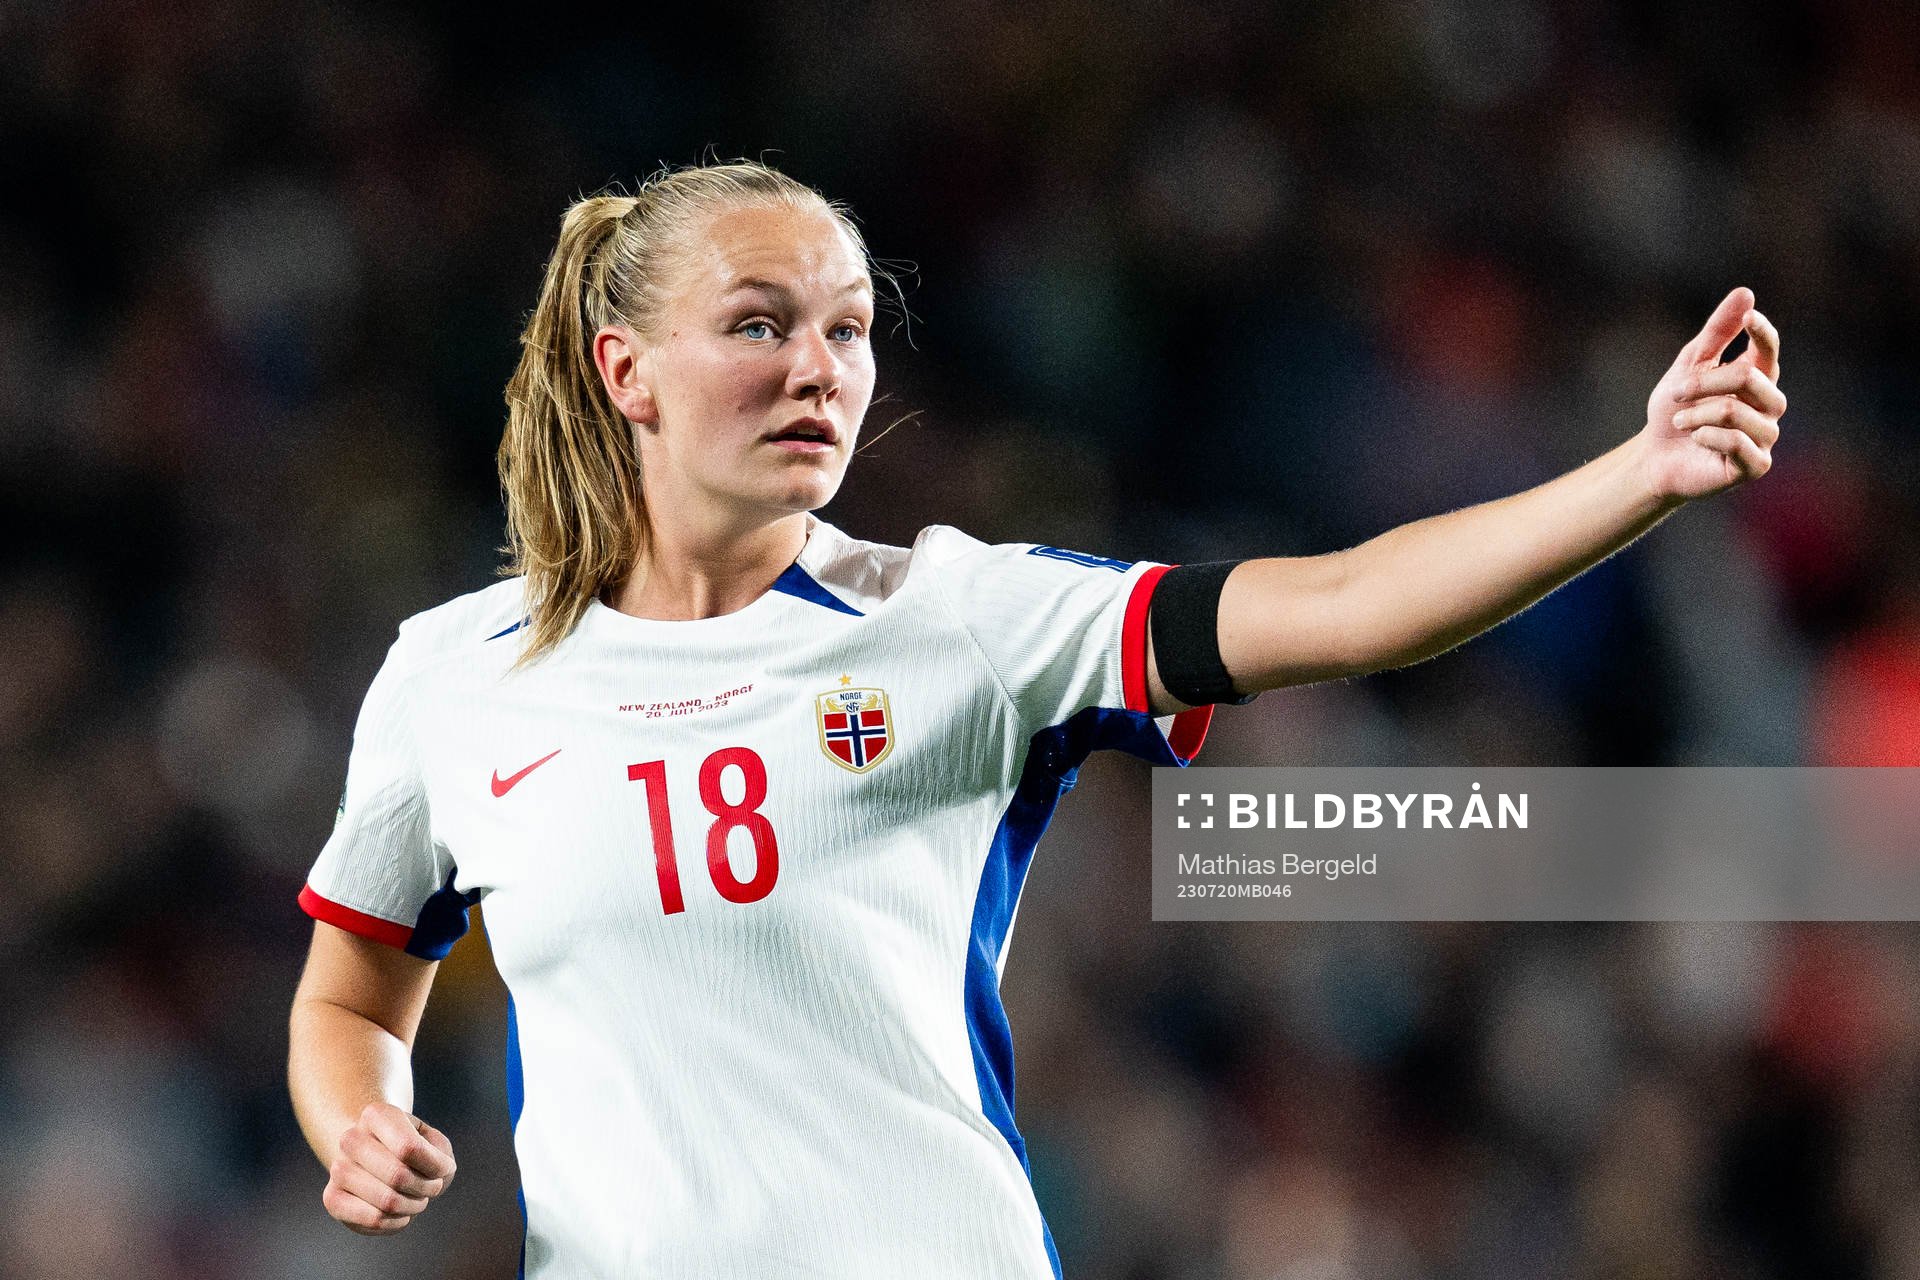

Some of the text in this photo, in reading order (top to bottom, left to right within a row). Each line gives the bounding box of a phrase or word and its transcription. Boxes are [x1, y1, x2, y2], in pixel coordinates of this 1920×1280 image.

[619, 704, 645, 712] NEW
[650, 699, 702, 711] ZEALAND
[715, 684, 754, 701] NORGE
[840, 692, 862, 701] NORGE
[668, 708, 694, 717] JULI
[698, 700, 729, 713] 2023
[627, 747, 779, 915] 18
